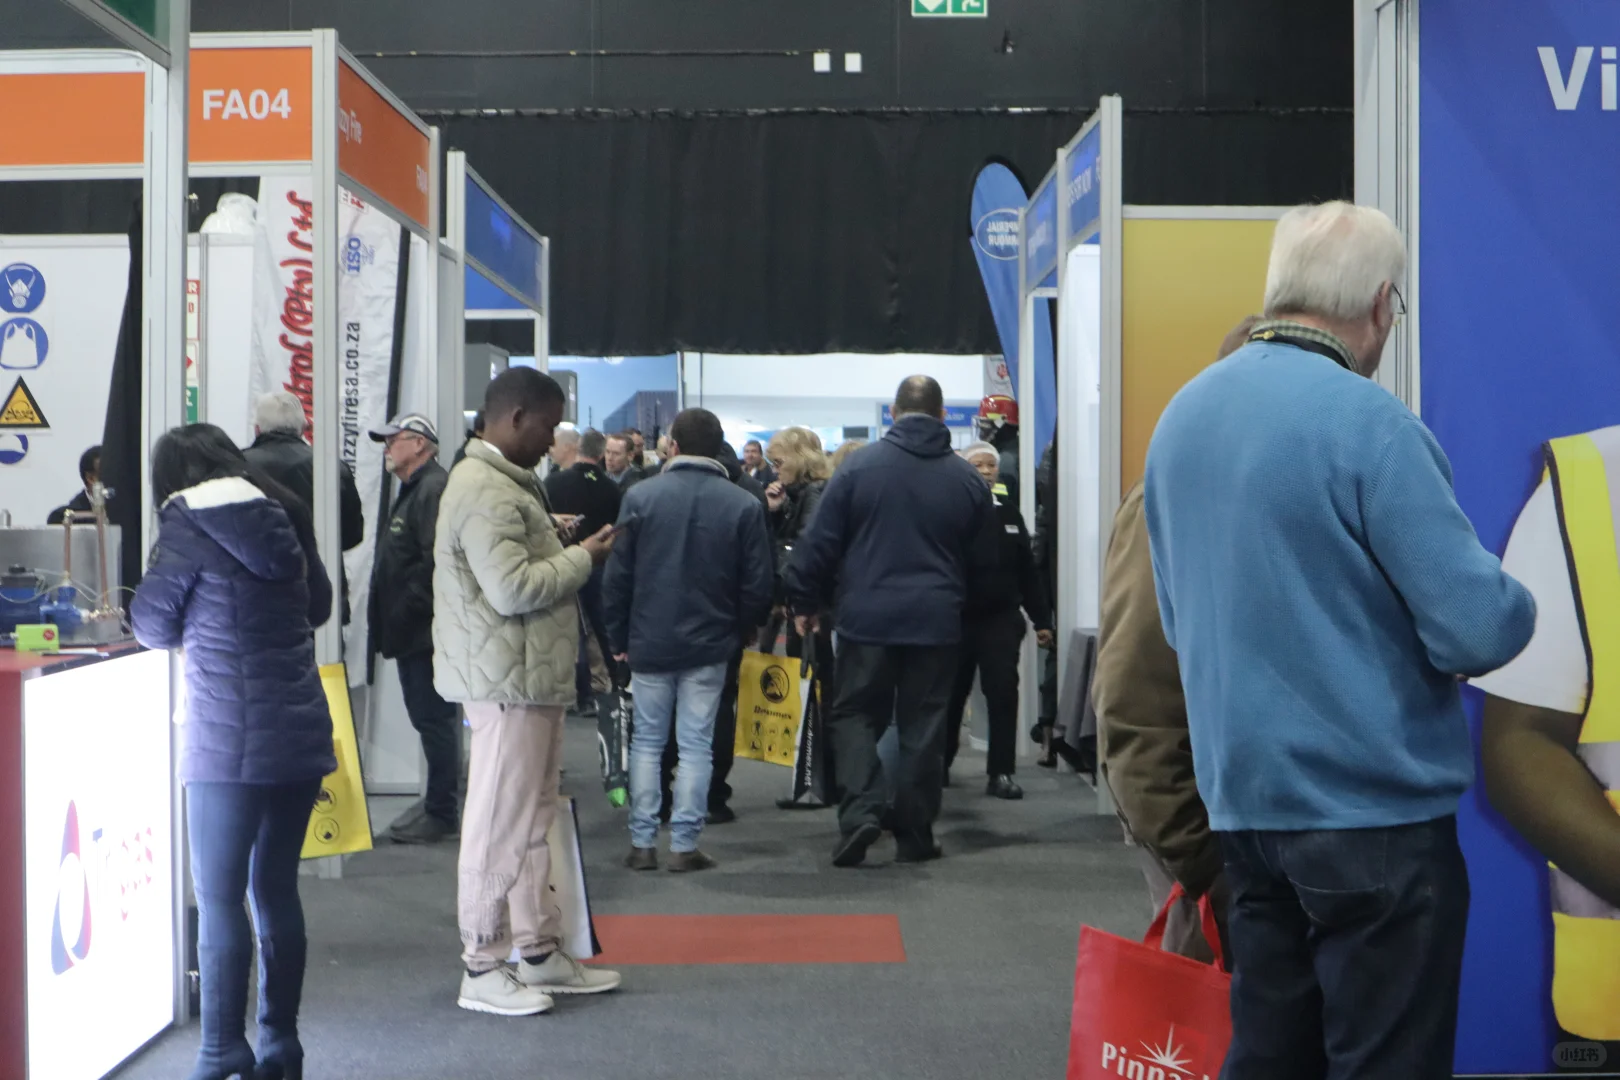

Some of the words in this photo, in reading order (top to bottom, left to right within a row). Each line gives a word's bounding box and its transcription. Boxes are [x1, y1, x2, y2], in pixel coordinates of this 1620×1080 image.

[1537, 46, 1617, 111] Vi
[202, 88, 292, 120] FA04
[347, 236, 361, 273] ISO
